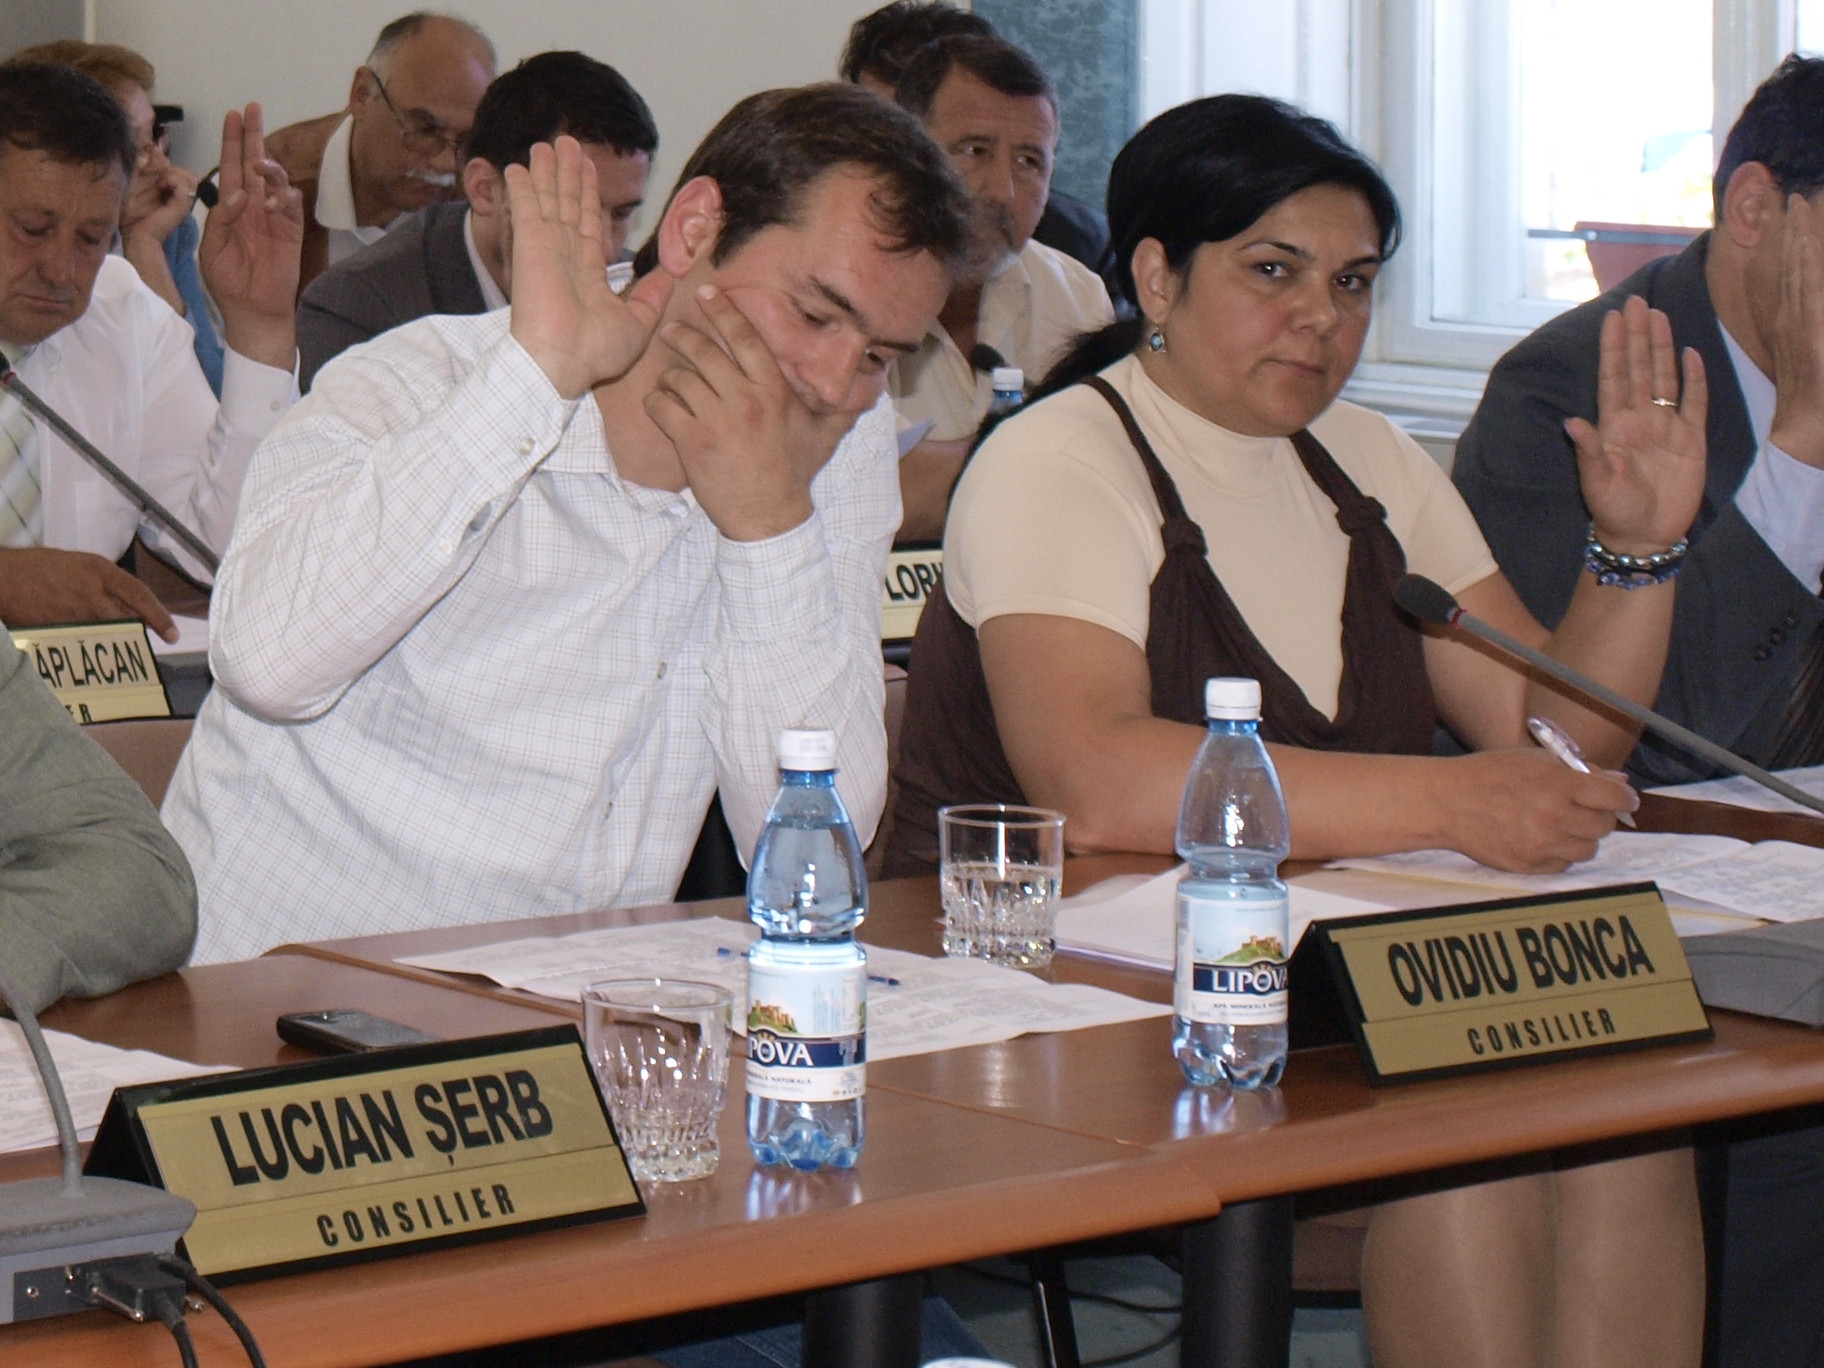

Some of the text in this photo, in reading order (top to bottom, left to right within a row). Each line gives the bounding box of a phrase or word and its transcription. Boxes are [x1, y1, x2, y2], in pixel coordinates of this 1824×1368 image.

[884, 563, 943, 601] LOR
[1387, 915, 1656, 1007] OVIDIU BONCA
[1467, 1008, 1617, 1056] CONSILIER
[210, 1090, 415, 1186] LUCIAN
[317, 1184, 516, 1248] CONSILIER
